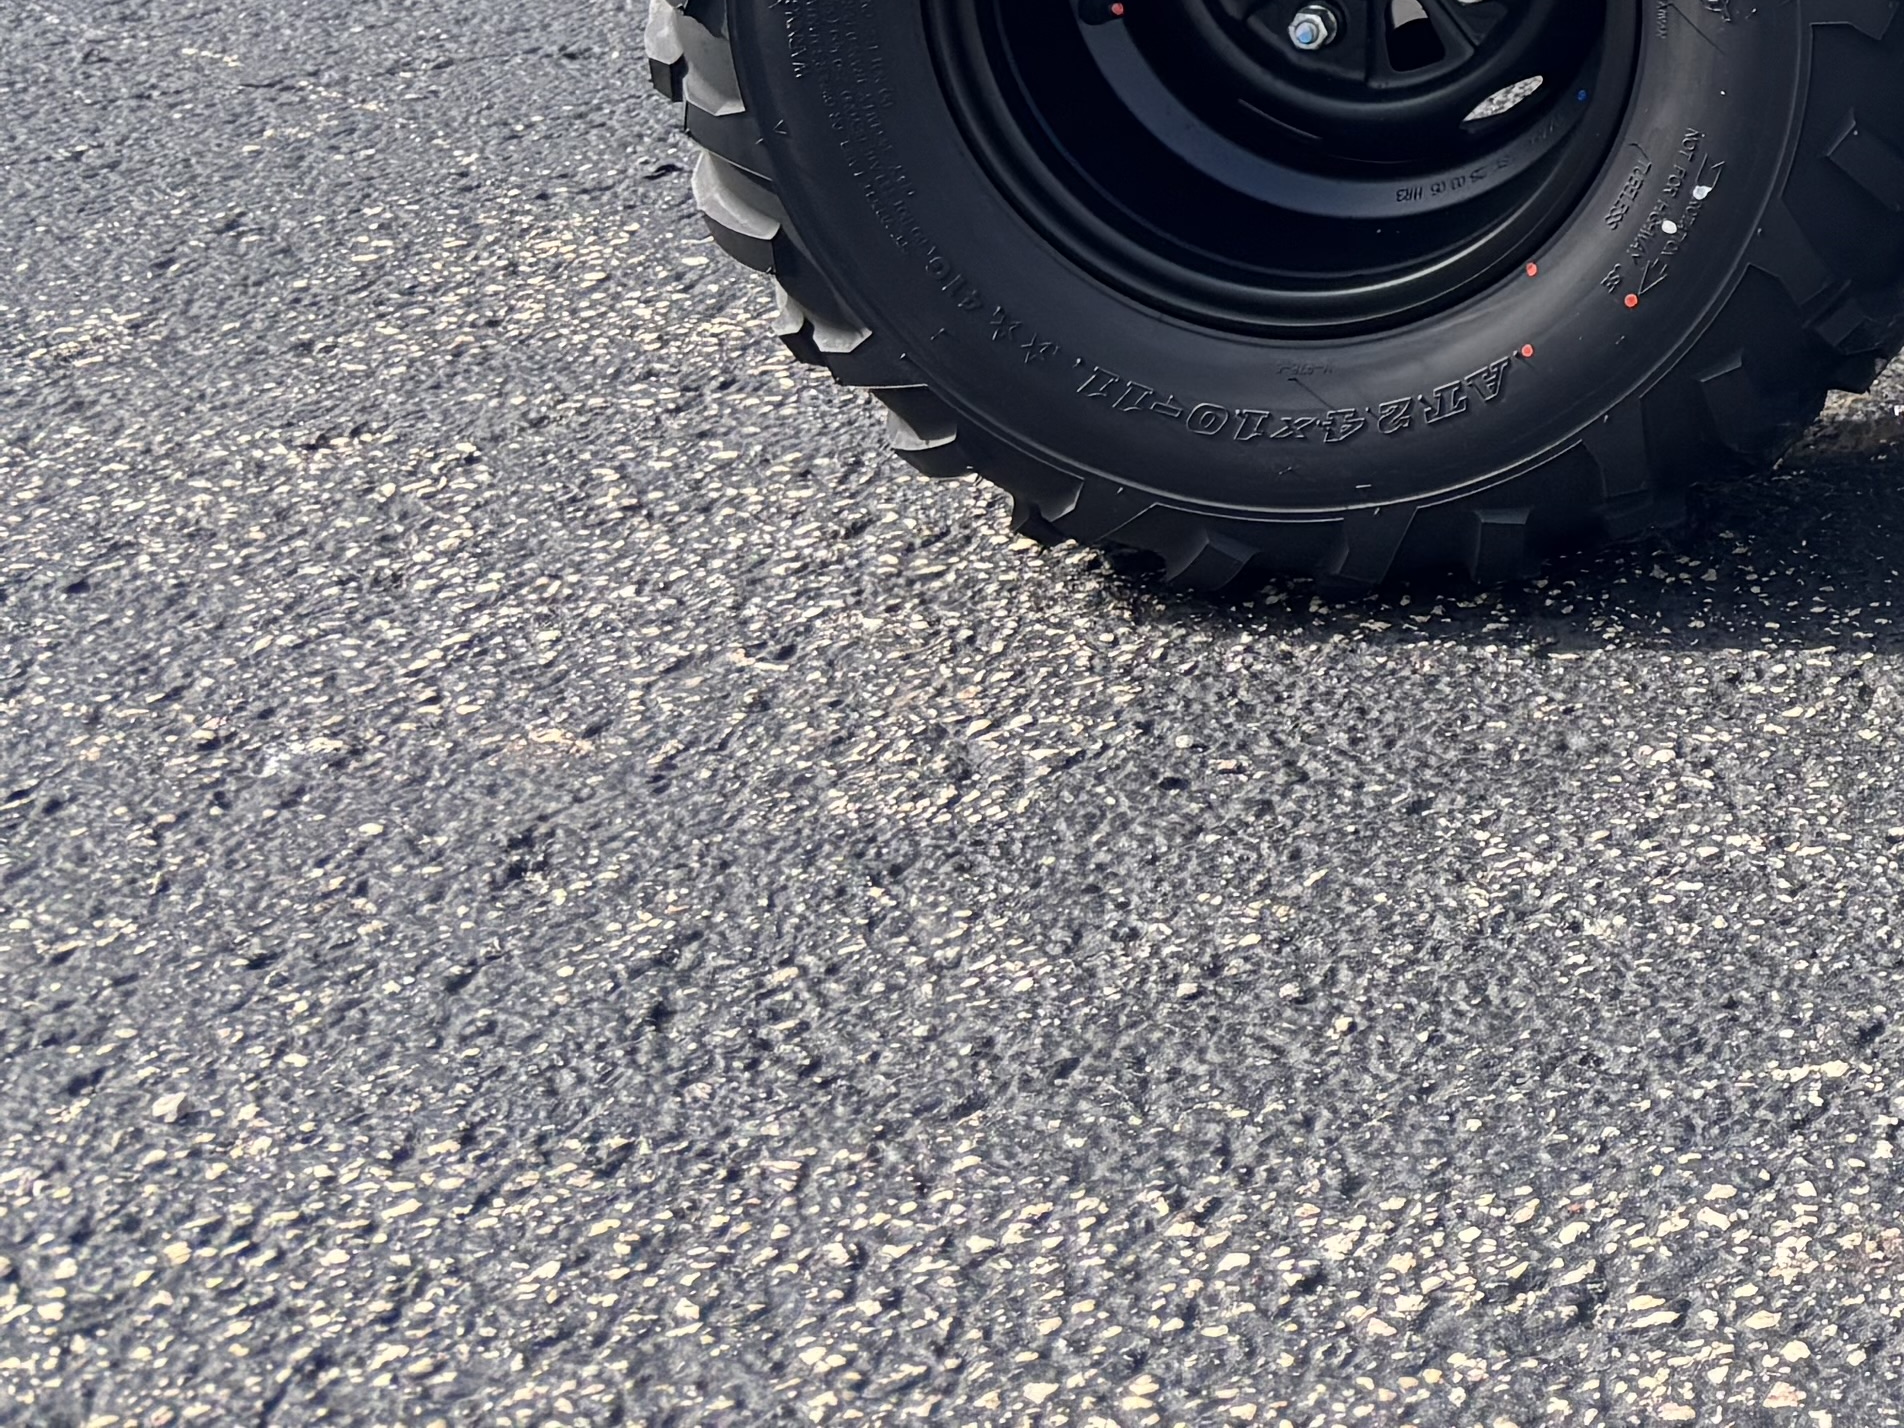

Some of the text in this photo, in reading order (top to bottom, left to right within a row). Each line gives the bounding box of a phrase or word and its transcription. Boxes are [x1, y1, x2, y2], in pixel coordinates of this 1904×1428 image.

[1679, 128, 1700, 161] NOT
[1604, 160, 1652, 230] TUBELESS
[1664, 165, 1686, 193] FOR
[1076, 356, 1514, 443] AT24x10-11
